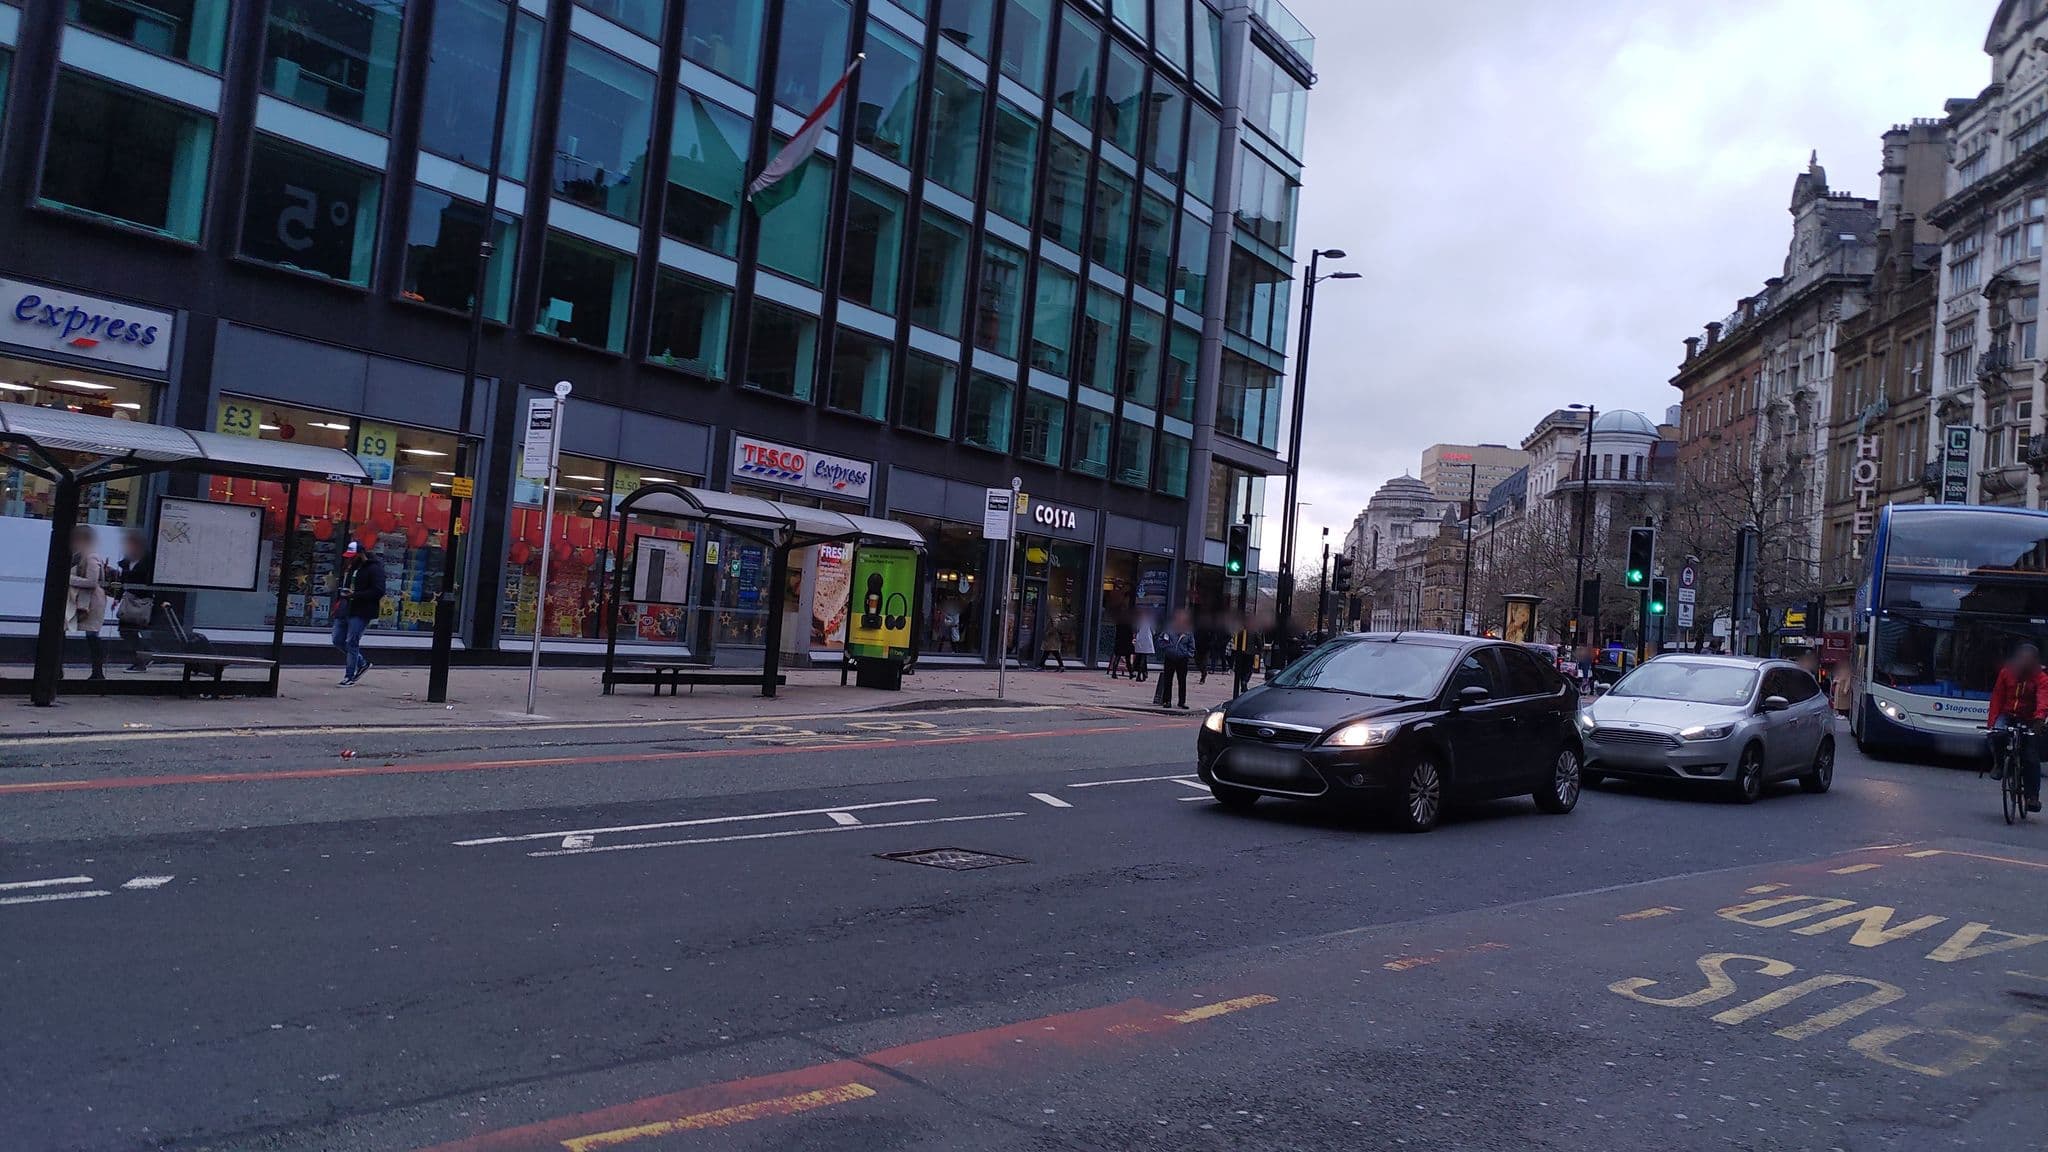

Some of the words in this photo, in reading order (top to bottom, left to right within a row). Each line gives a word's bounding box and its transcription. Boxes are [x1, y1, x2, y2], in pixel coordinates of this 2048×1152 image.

[15, 294, 158, 346] express
[223, 405, 253, 430] £3
[362, 435, 388, 457] £9
[741, 443, 805, 473] TESCO
[814, 459, 868, 485] express
[1852, 434, 1879, 560] HOTEL
[1035, 504, 1077, 529] COSTA
[820, 545, 849, 560] FRESH
